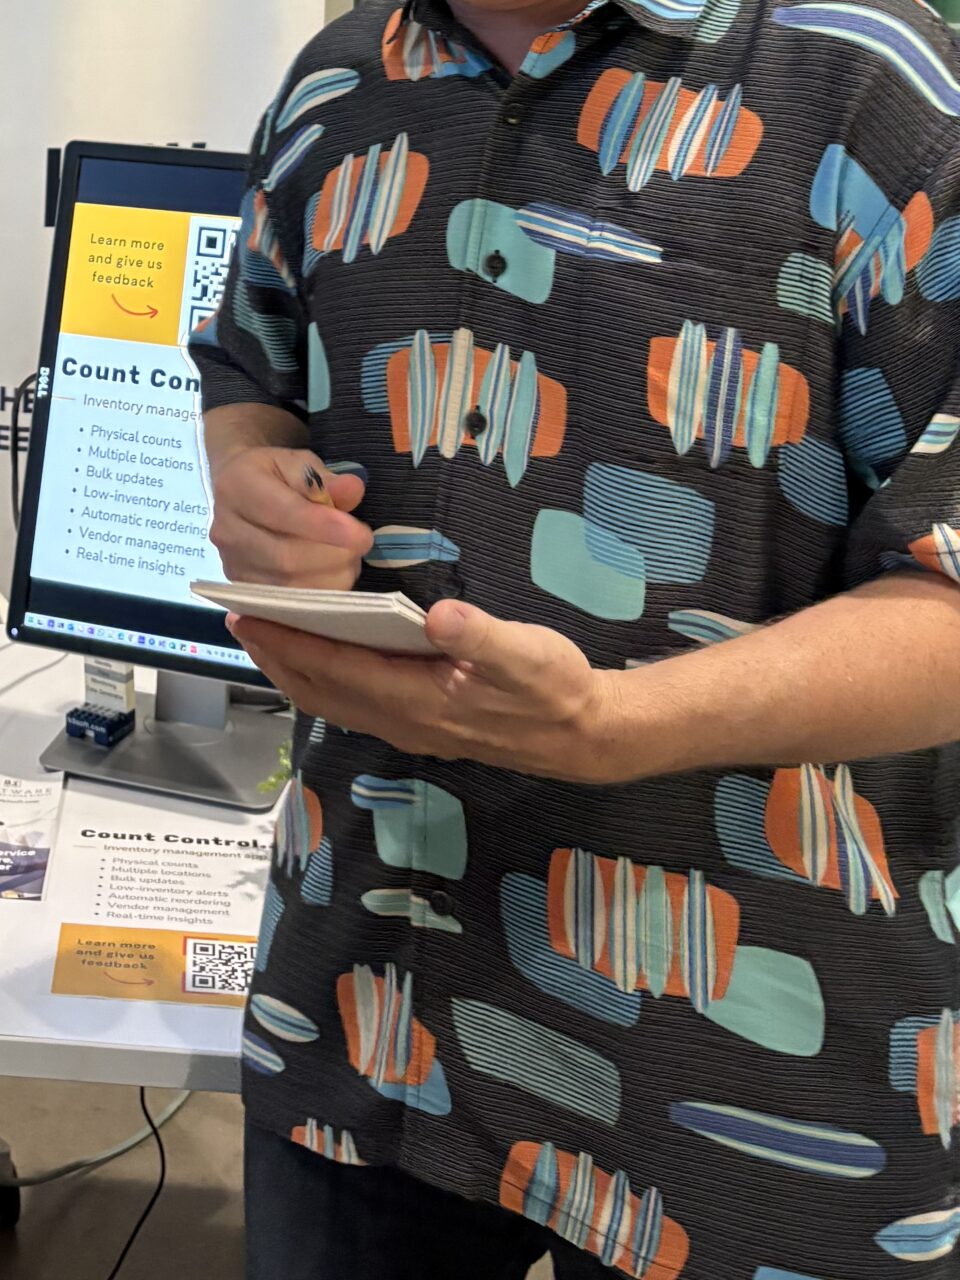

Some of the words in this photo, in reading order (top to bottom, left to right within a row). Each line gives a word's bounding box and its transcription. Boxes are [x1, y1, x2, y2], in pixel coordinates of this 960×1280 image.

[90, 233, 126, 247] Learn
[131, 240, 164, 251] more
[88, 253, 112, 265] and
[116, 256, 143, 269] give
[148, 259, 162, 270] us
[92, 271, 154, 288] feedback
[62, 357, 140, 385] Count
[83, 394, 143, 415] Inventory
[146, 404, 202, 422] manage
[91, 425, 139, 442] Physical
[142, 434, 182, 449] counts
[88, 445, 137, 463] Multiple
[140, 453, 194, 471] locations
[86, 465, 112, 480] Bulk
[116, 471, 164, 488] updates
[84, 485, 171, 512] Low-inventory
[173, 500, 208, 516] alerts
[81, 506, 142, 527] Automatic
[145, 518, 208, 539] reordering
[79, 526, 122, 544] Vendor
[125, 536, 206, 558] management
[76, 546, 135, 567] Real-time
[138, 557, 186, 576] insights
[81, 829, 156, 841] Count
[163, 834, 273, 849] Control.
[104, 844, 160, 854] Inventory
[163, 848, 241, 858] management
[113, 857, 159, 866] Physical
[112, 866, 158, 875] Multiple
[161, 869, 212, 878] locations
[109, 884, 193, 896] Low-inventory
[139, 877, 185, 886] updates
[108, 892, 168, 902] Automatic
[171, 898, 231, 907] reordering
[107, 902, 149, 910] Vendor
[153, 906, 230, 916] management
[106, 911, 165, 921] Real-time
[167, 915, 214, 925] insights
[77, 939, 116, 947] Learn
[81, 959, 148, 969] feedback
